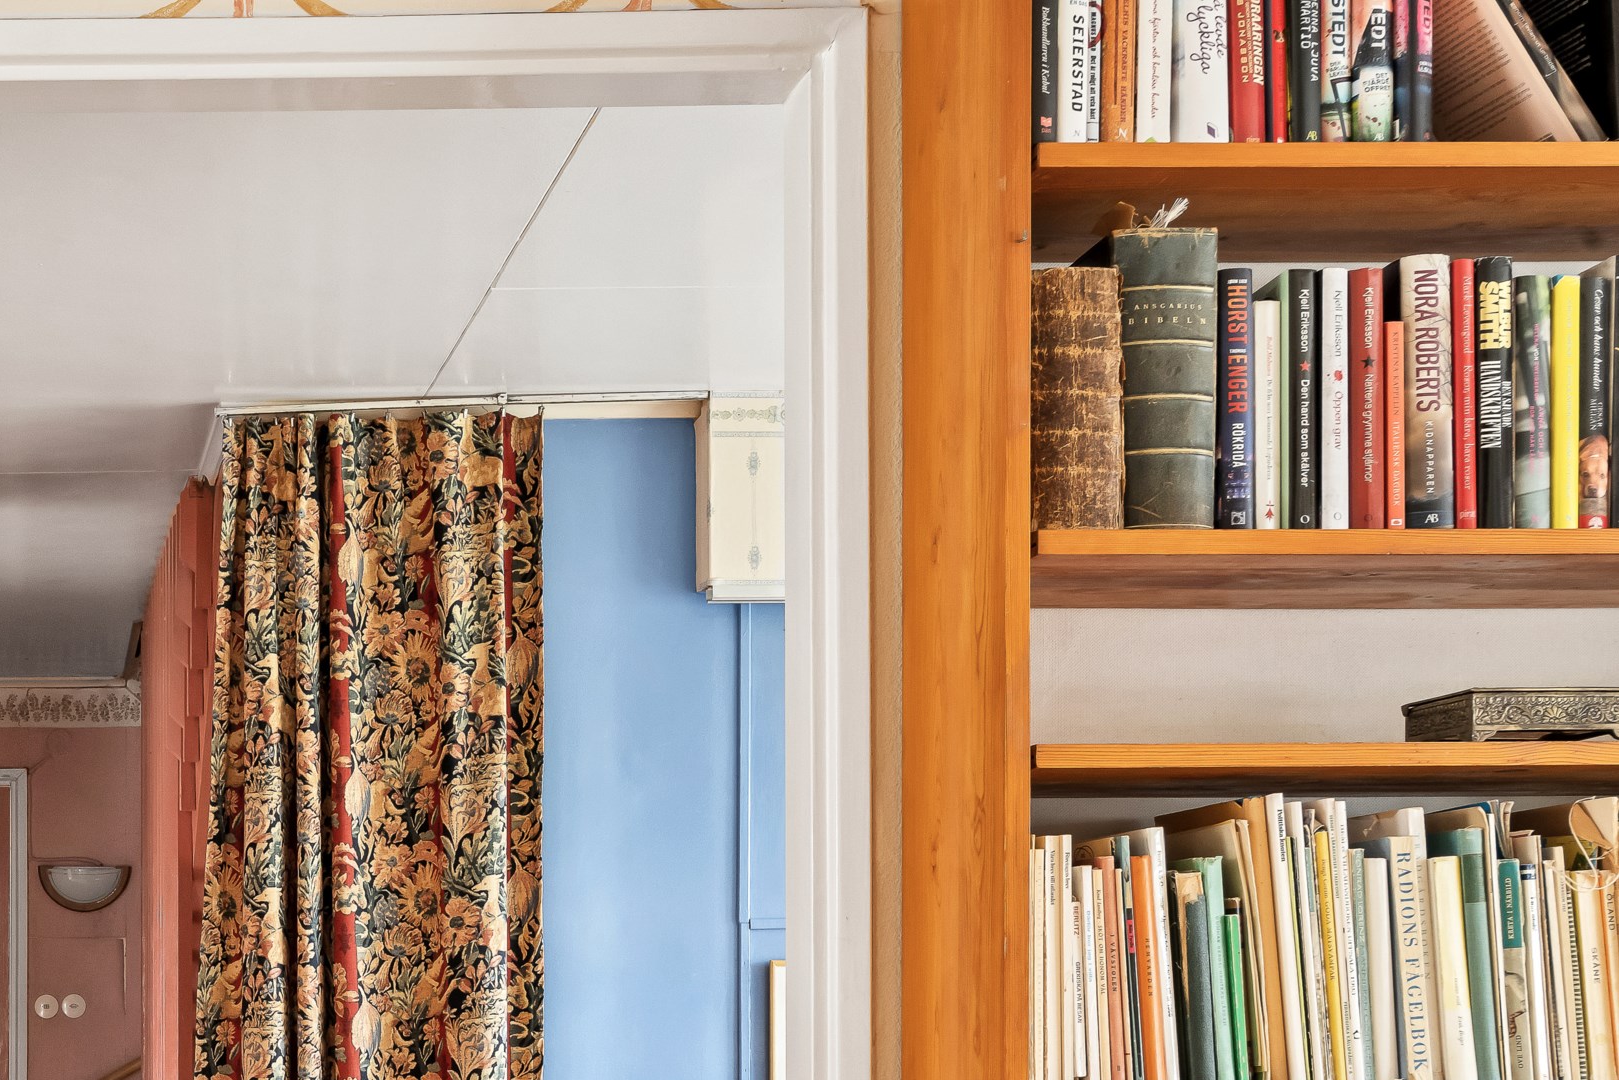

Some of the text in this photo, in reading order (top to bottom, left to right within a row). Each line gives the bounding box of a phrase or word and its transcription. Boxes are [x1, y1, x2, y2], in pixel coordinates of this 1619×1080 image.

[1040, 6, 1052, 95] Bokhandlaren Kabul
[1186, 5, 1216, 75] lyckliga
[1237, 12, 1250, 83] JONASSON
[1331, 0, 1346, 56] STEDT
[1071, 14, 1085, 113] SEIERSTAD
[1120, 30, 1129, 82] VACKRASTE
[1309, 42, 1319, 82] LJUVA
[1134, 302, 1203, 311] ANSGARIUS
[1362, 287, 1375, 308] Kjell
[1462, 276, 1473, 300] Mark
[1128, 316, 1207, 326] BIBELN
[1227, 285, 1248, 345] HORST
[1364, 309, 1375, 349] Eriksson
[1479, 280, 1500, 350] SMITH
[1498, 280, 1512, 350] WILBUR
[1413, 269, 1441, 412] NORA ROBERTS
[1592, 289, 1604, 392] Cesar och hans hundar
[1227, 355, 1248, 414] ENGER
[1298, 289, 1310, 488] Kjell Eriksson Den hand som skälver
[1332, 290, 1345, 450] Kjell Eriksson Öppen grav
[1364, 374, 1375, 410] Nattens
[1392, 376, 1400, 416] KAPPELIN
[1462, 396, 1473, 415] min
[1480, 360, 1502, 449] HANDSKRIFTEN
[1232, 422, 1247, 468] RÖKRIDÅ
[1361, 411, 1373, 448] grymma
[1393, 422, 1401, 467] ITALIENSK
[1463, 443, 1474, 464] bara
[1425, 420, 1436, 494] KIDNAPPAREN
[1463, 466, 1474, 490] rosor
[1393, 470, 1401, 507] DAGBOK
[1606, 893, 1616, 931] ÖLAND
[1396, 852, 1429, 1072] RADIONS FÅGELBOK
[1590, 947, 1602, 985] SKÅNE
